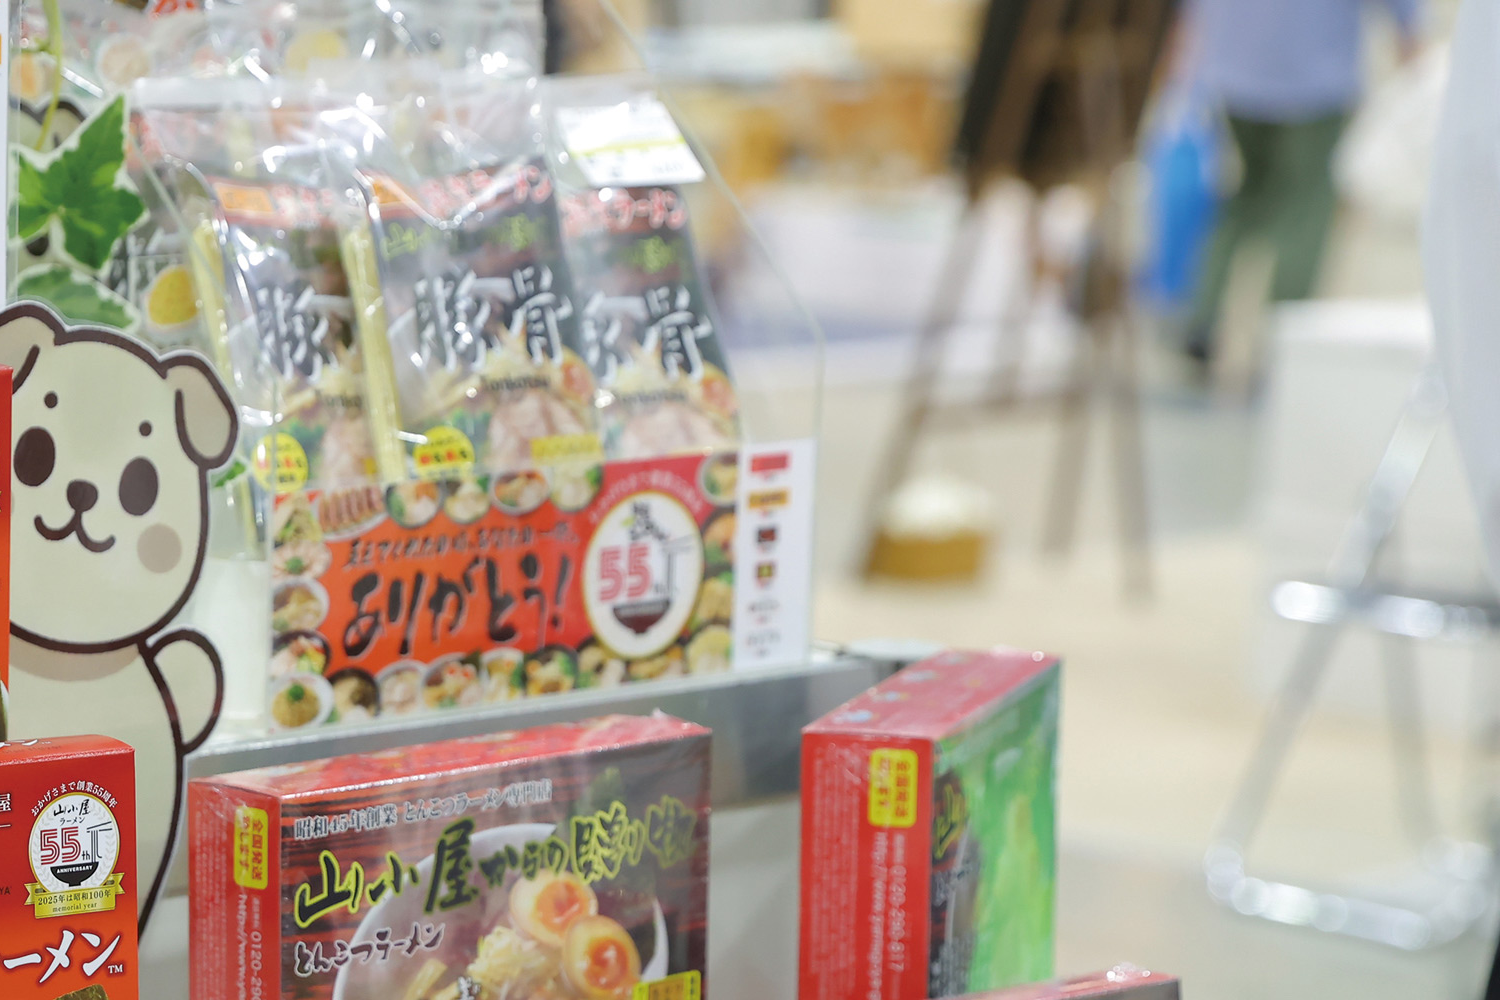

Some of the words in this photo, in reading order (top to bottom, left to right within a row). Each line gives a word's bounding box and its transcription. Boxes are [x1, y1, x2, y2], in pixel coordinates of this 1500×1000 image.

[60, 816, 85, 825] ラーメン
[294, 802, 398, 841] 昭和45年創業
[251, 818, 263, 882] 全国発送
[57, 865, 93, 875] ANNIVERSARY
[38, 890, 111, 906] 2025年は昭和100年
[52, 903, 81, 913] memorial
[83, 901, 98, 911] year
[292, 921, 447, 977] とんこつラーメン
